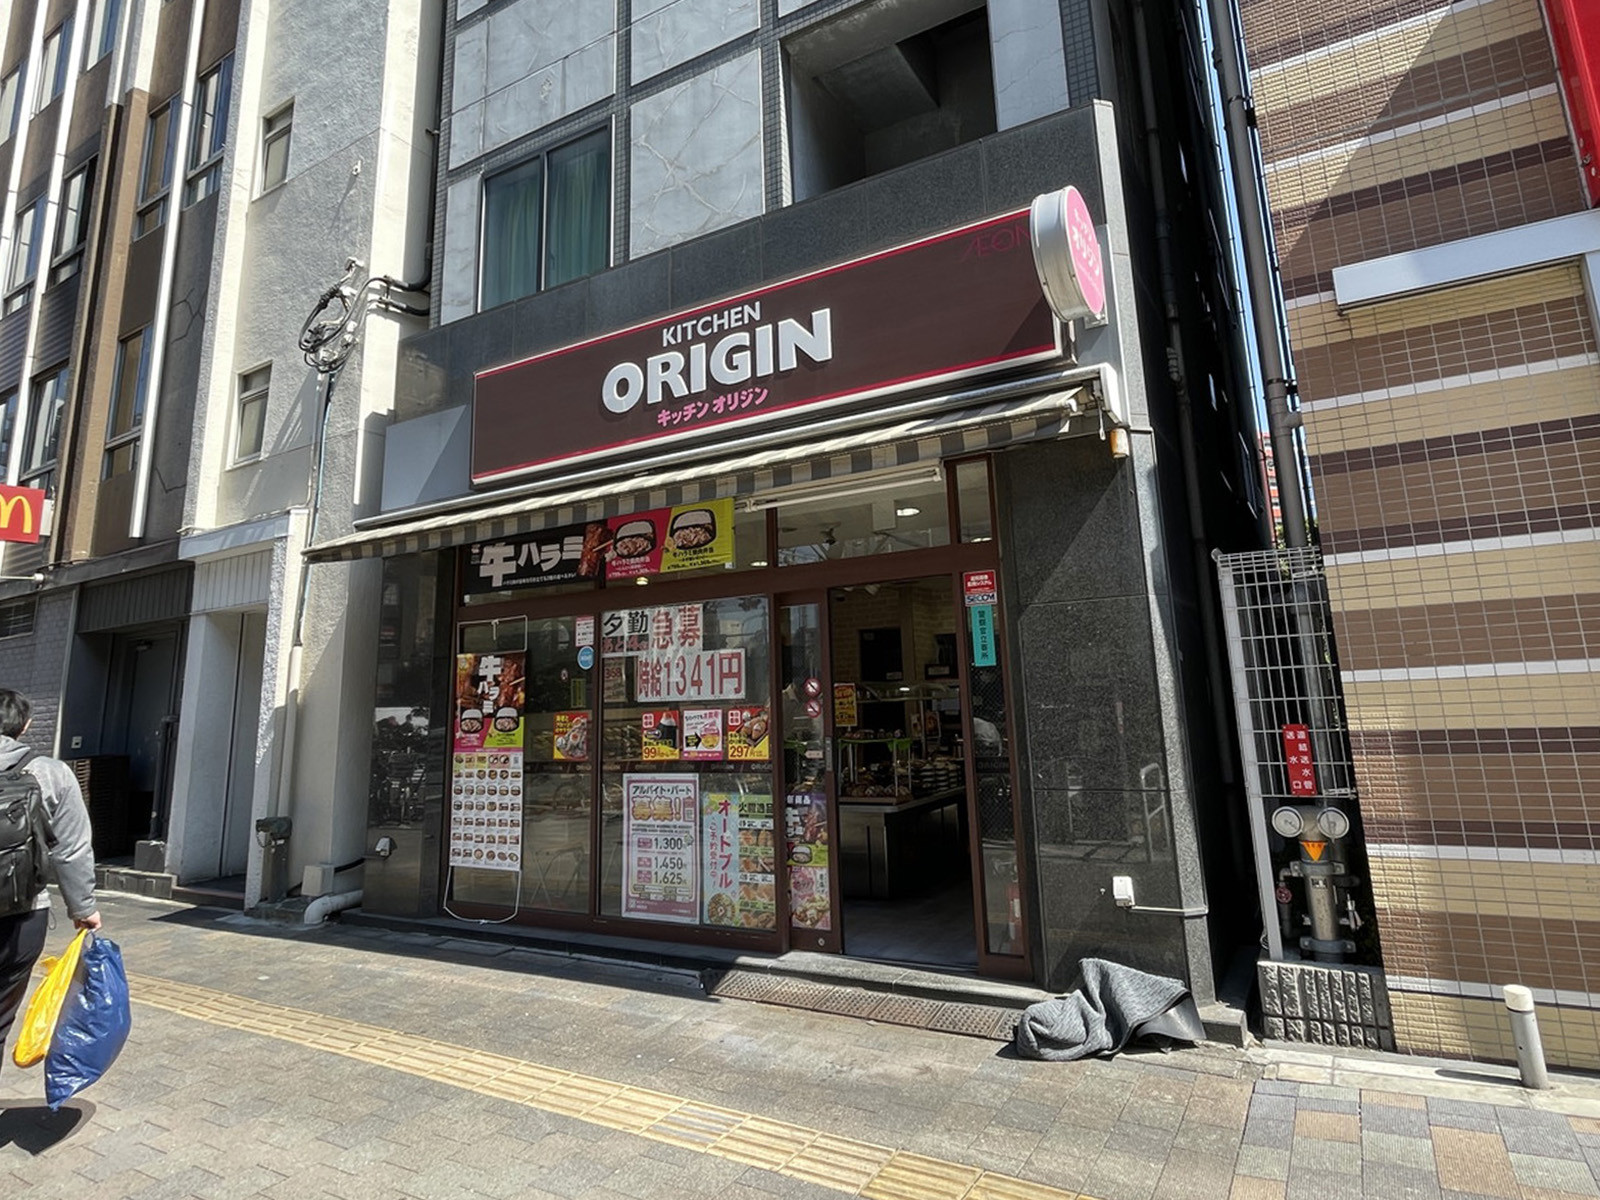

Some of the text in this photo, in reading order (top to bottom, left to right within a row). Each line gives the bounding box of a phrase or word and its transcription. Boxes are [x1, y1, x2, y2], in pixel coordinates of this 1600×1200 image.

[662, 301, 761, 347] KITCHEN
[601, 308, 833, 414] ORIGIN
[657, 387, 769, 427] キッチン オリジン
[479, 536, 584, 588] 牛ハラミ
[967, 593, 995, 603] SECOM
[477, 655, 502, 713] 牛ハラミ
[638, 651, 742, 697] 時給1341円
[643, 746, 657, 759] 99
[729, 745, 750, 758] 297
[718, 800, 733, 889] オートブル
